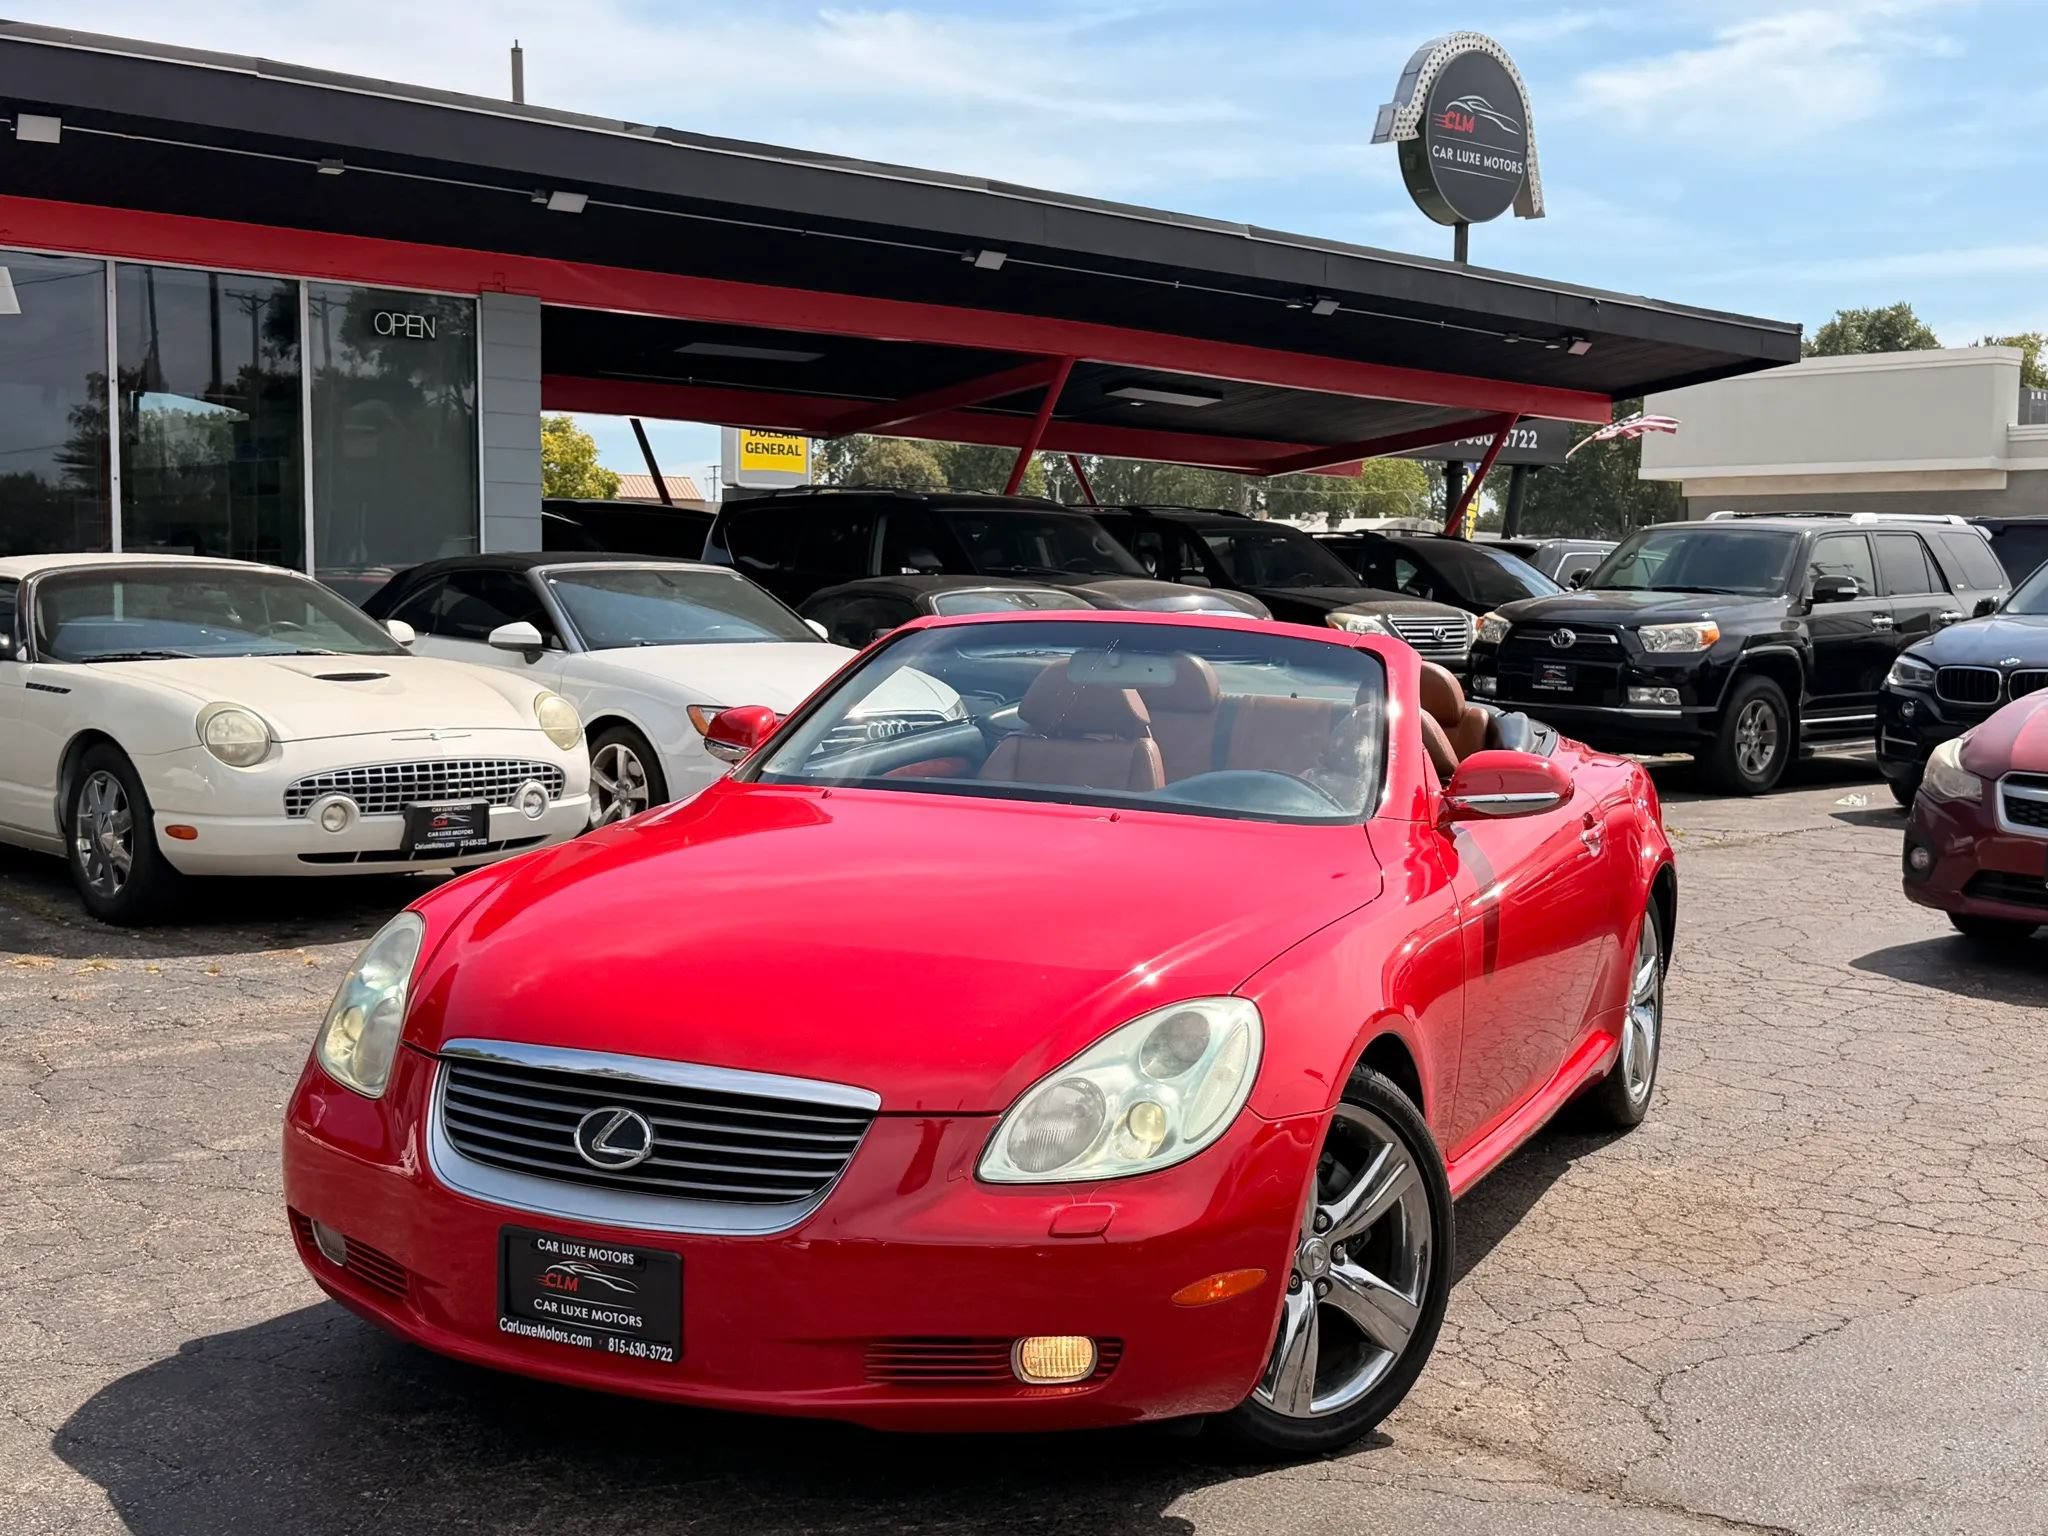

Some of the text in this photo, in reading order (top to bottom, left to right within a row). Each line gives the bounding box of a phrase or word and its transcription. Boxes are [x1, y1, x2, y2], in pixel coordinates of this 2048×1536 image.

[1444, 111, 1477, 133] CLM
[1432, 145, 1523, 175] CAR LUXE MOTORS
[374, 311, 436, 338] OPEN
[745, 441, 802, 456] GENERAL
[537, 1238, 634, 1265] CAR LUXE MOTORS
[544, 1272, 580, 1292] CLM
[533, 1298, 643, 1328] CAR LUXE MOTORS
[499, 1317, 673, 1363] CarLuxeMotors.com 815-630-3722
